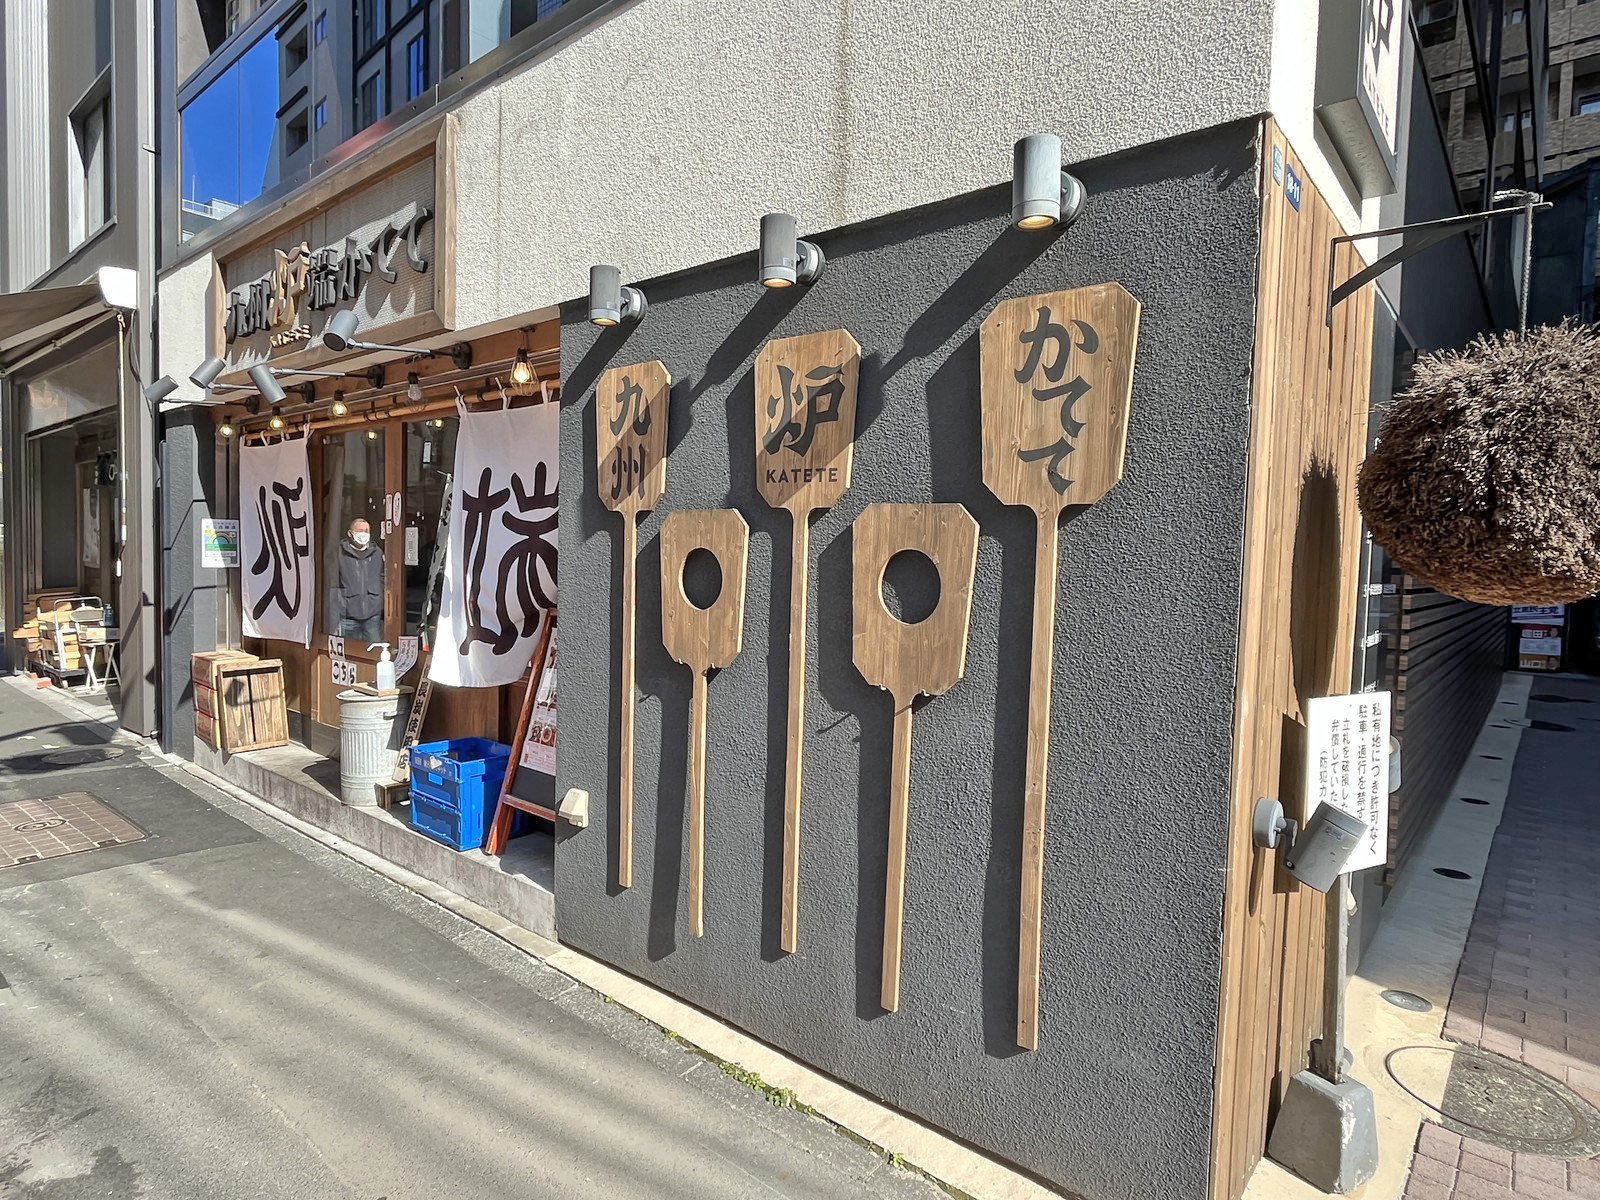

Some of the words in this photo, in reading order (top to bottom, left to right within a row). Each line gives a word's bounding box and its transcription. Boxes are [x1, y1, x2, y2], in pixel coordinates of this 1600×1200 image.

[609, 375, 652, 500] 九州
[764, 362, 847, 458] 炉
[1013, 305, 1100, 496] かてて
[765, 467, 838, 484] KATETE
[330, 639, 344, 657] 入口
[333, 661, 355, 684] こちら
[1369, 702, 1382, 855] 私有地につき許可なく
